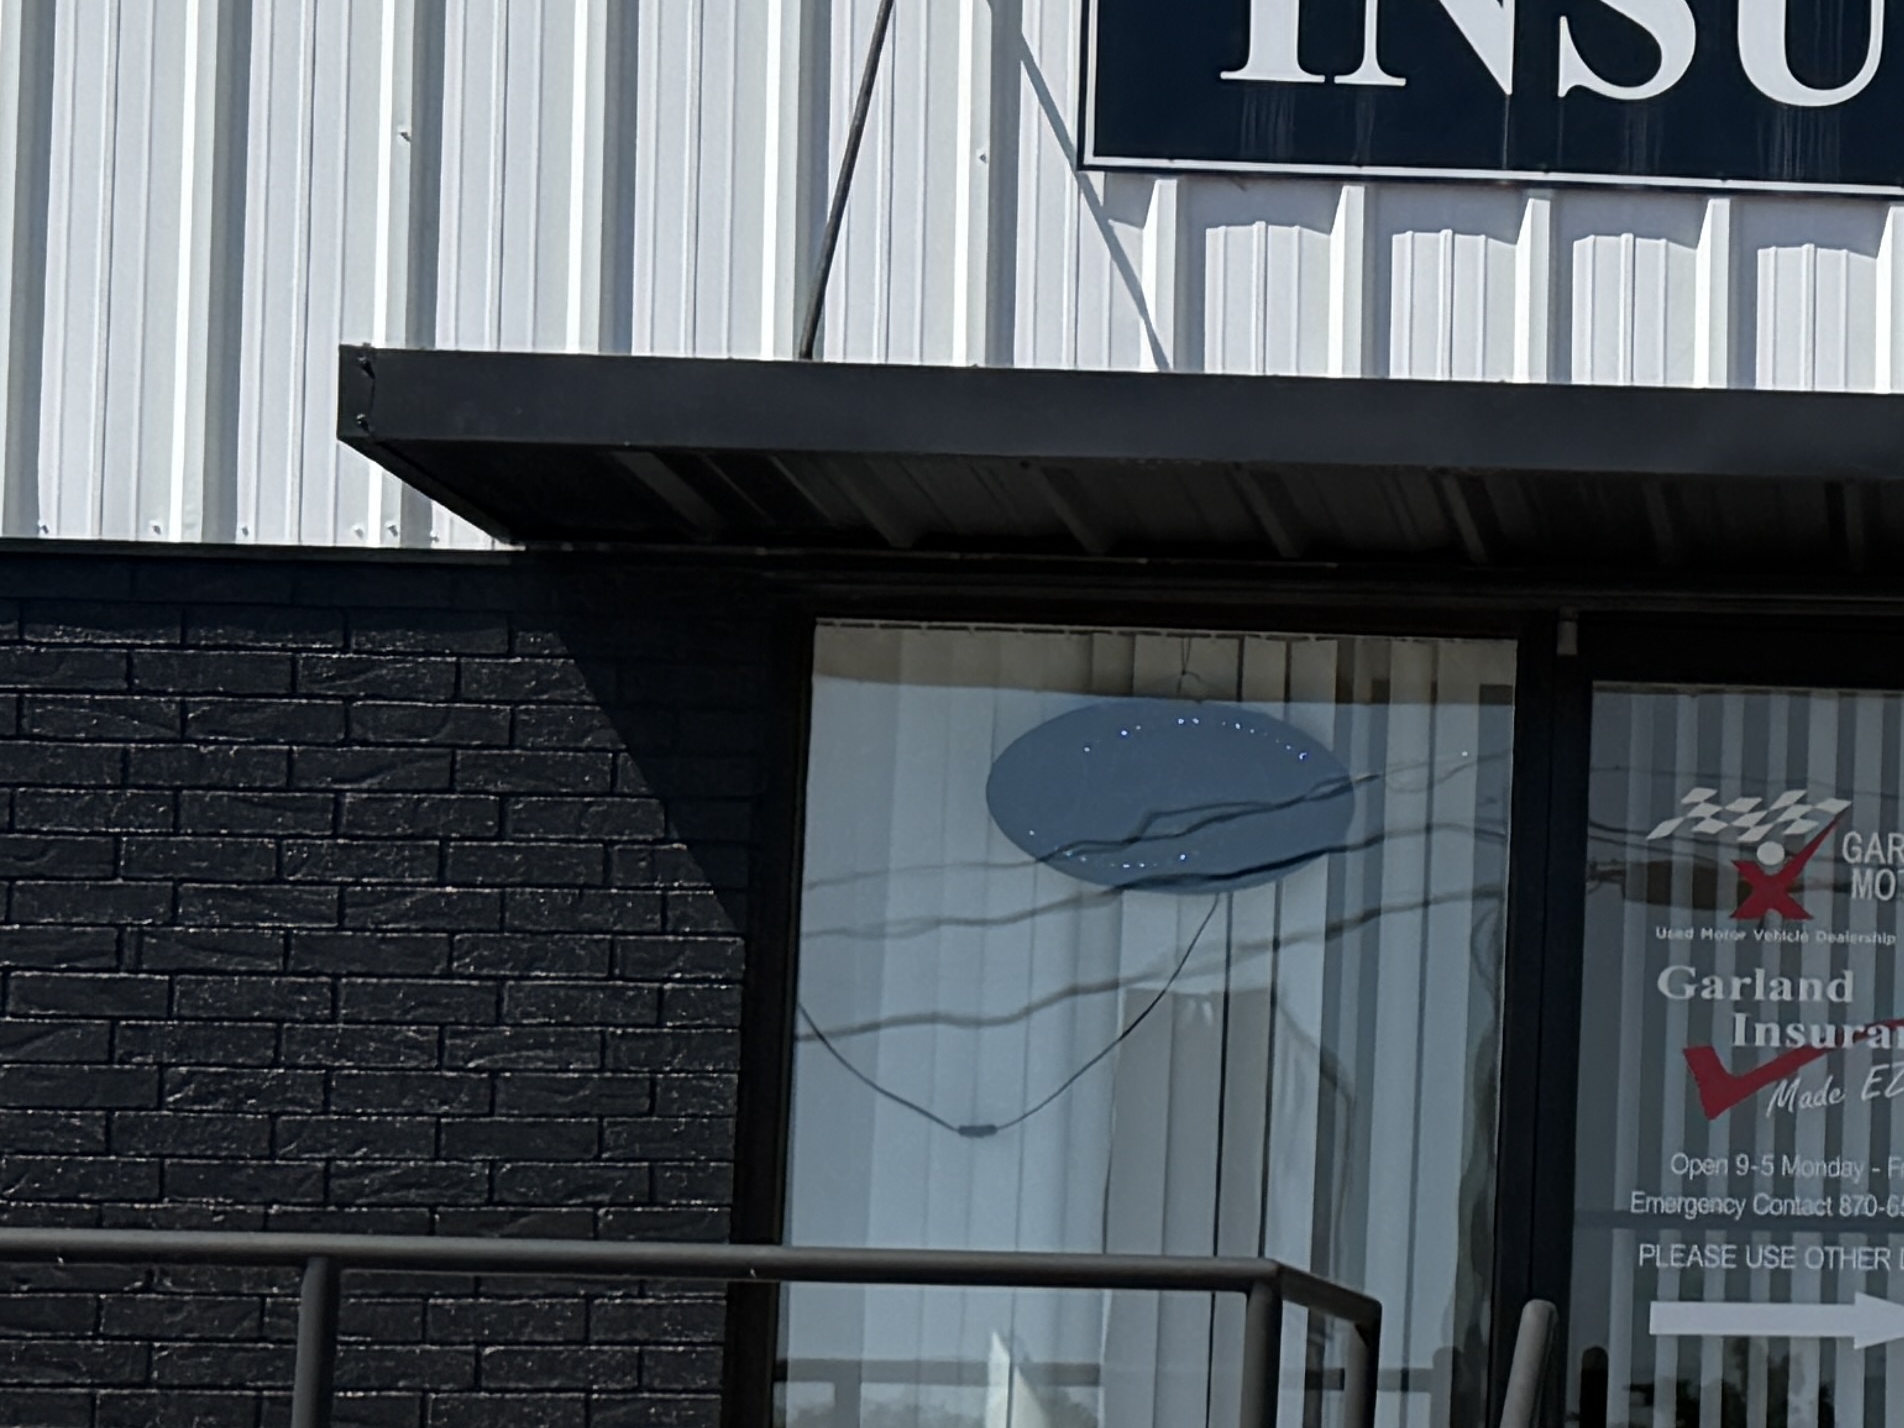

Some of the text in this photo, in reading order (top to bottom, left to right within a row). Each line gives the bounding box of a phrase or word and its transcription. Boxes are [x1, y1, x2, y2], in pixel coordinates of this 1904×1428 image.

[1656, 926, 1897, 946] Used Motor Vehicle Dealership
[1657, 965, 1854, 1003] Garland
[1766, 1075, 1846, 1118] Made
[1670, 1152, 1728, 1180] Open
[1735, 1153, 1774, 1176] 9-5
[1781, 1155, 1864, 1185] Monday
[1630, 1191, 1746, 1220] Emergency
[1752, 1192, 1833, 1218] Contact
[1638, 1243, 1738, 1269] PLEASE
[1745, 1245, 1796, 1270] USE
[1804, 1246, 1891, 1271] OTHER
